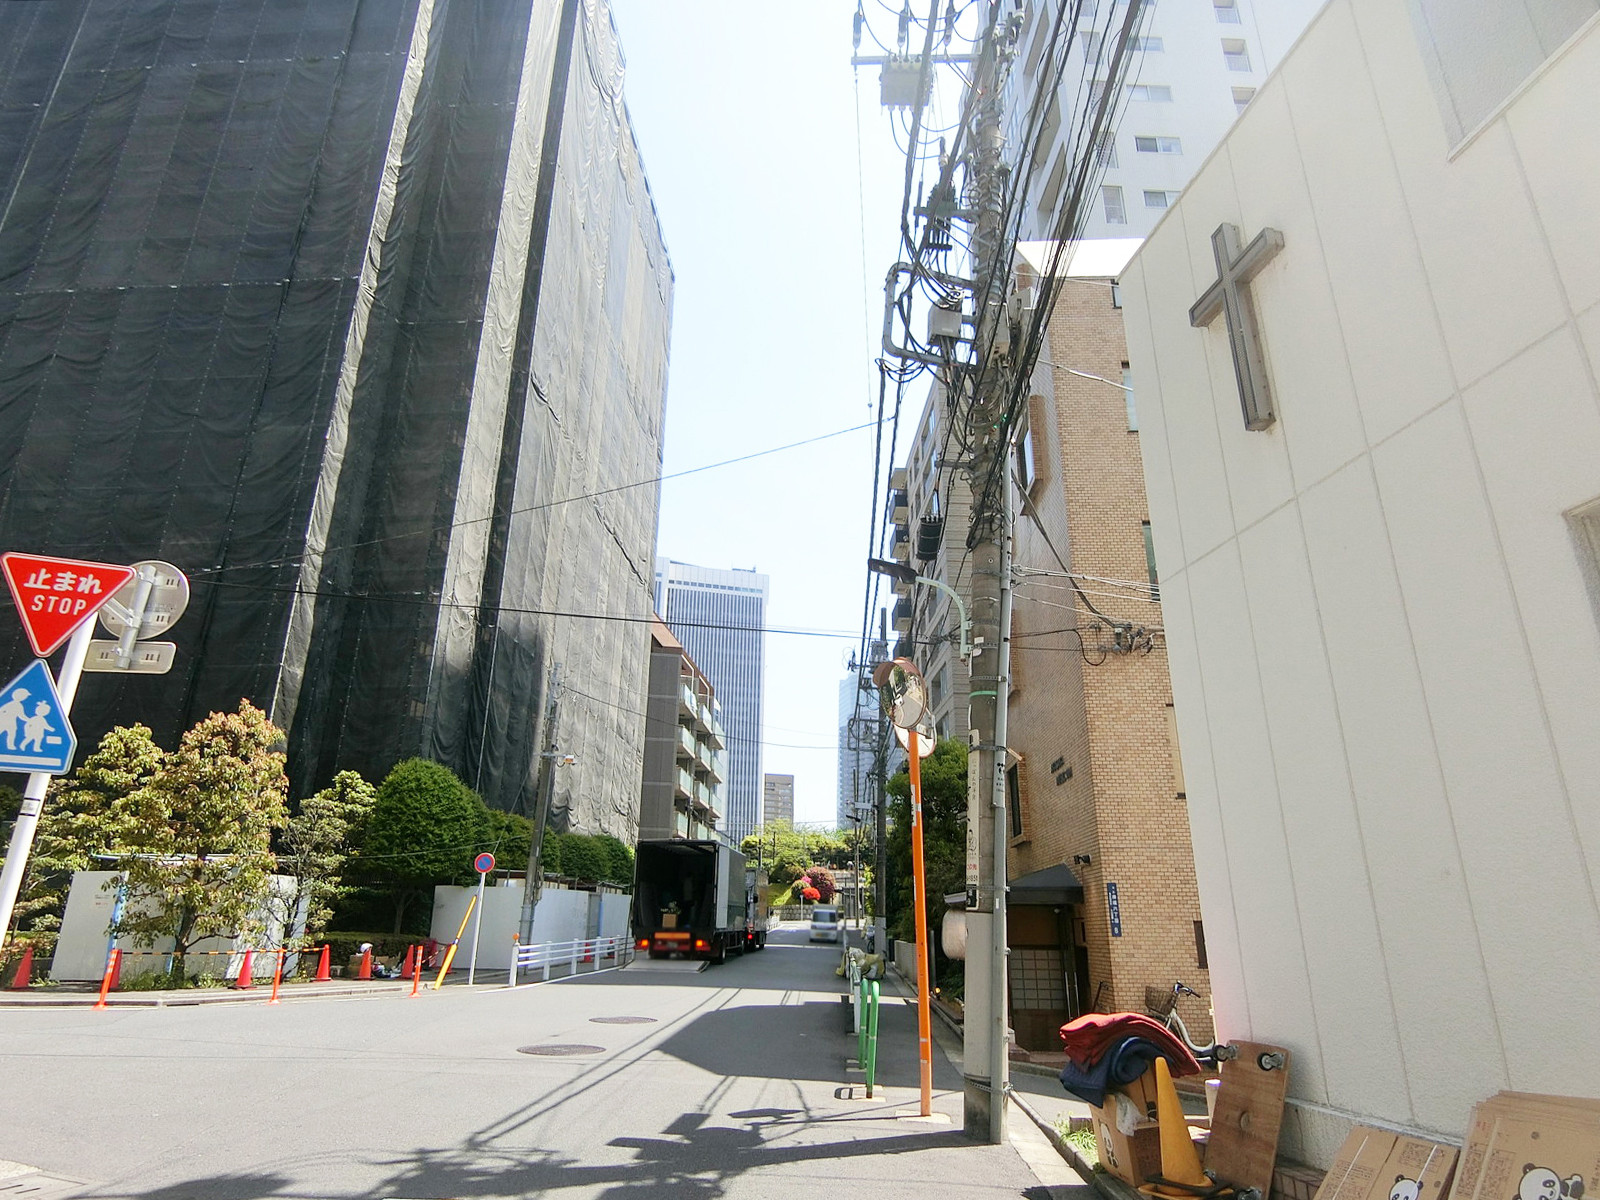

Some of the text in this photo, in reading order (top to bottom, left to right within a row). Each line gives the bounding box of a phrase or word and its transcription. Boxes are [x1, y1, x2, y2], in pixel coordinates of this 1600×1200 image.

[23, 568, 102, 594] 止まれ
[31, 594, 87, 615] STOP
